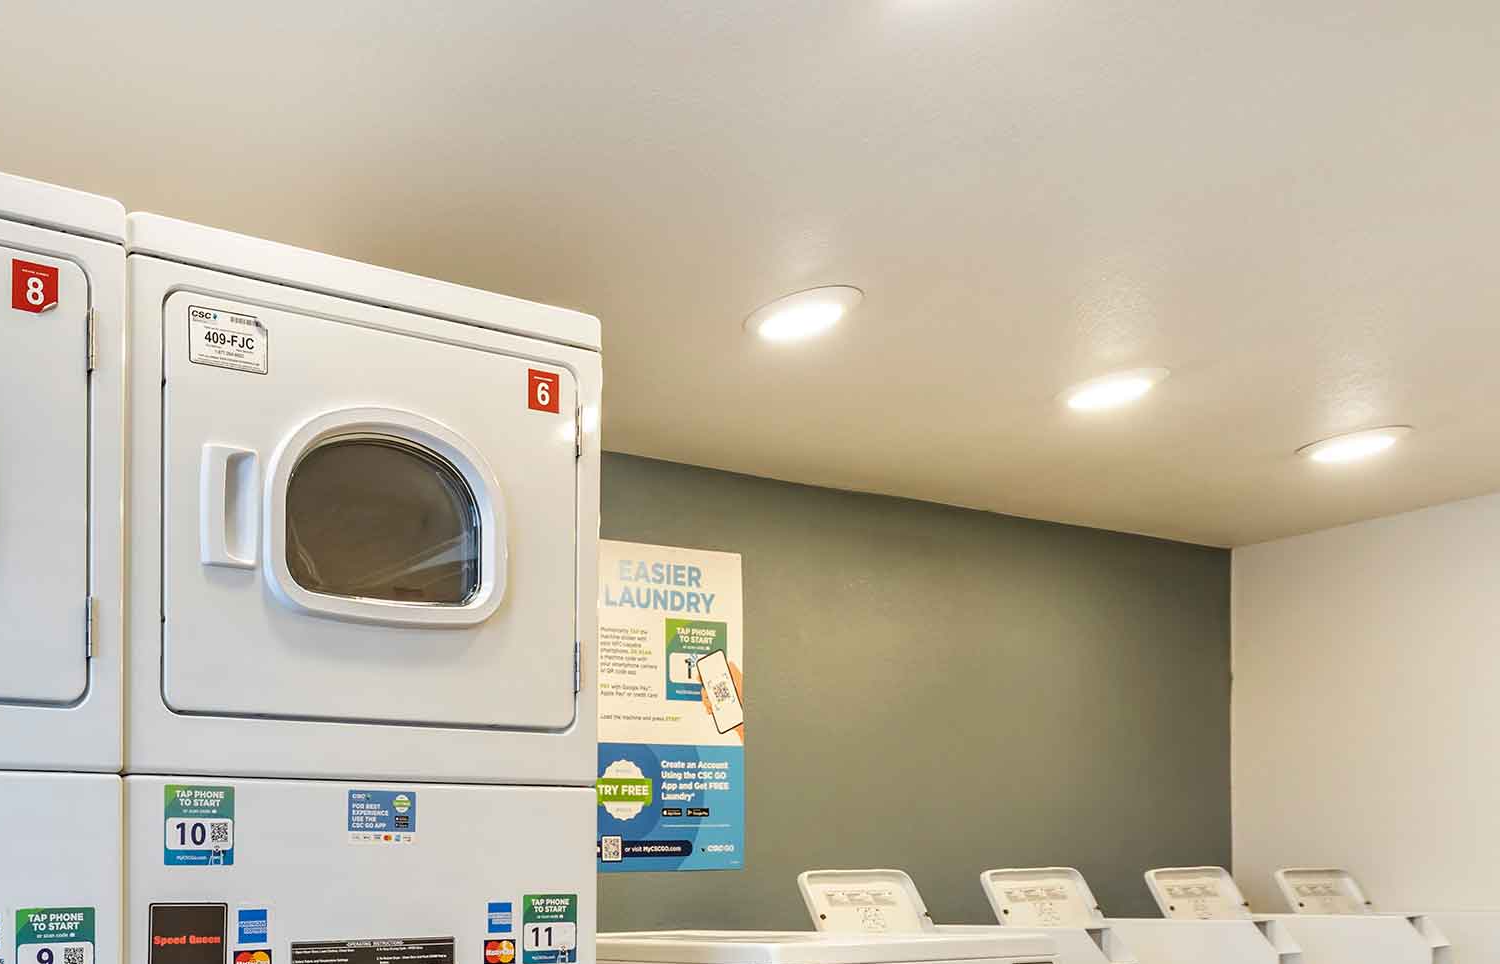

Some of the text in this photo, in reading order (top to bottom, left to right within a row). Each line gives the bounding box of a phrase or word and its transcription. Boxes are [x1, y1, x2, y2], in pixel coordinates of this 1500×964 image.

[26, 277, 45, 306] 8
[191, 309, 212, 320] CSC
[204, 330, 255, 350] 409-FJC
[537, 382, 550, 406] 6
[619, 559, 702, 589] EASIER
[604, 584, 716, 614] LAUNDRY
[176, 790, 225, 799] TAP PHONE
[597, 784, 650, 796] TRY FREE
[179, 798, 221, 807] TO START
[176, 822, 206, 846] 10
[531, 898, 570, 906] TAP PHONE
[534, 905, 567, 913] TO START
[28, 912, 84, 923] TAP PHONE
[32, 922, 80, 931] TO START
[531, 926, 552, 947] 11
